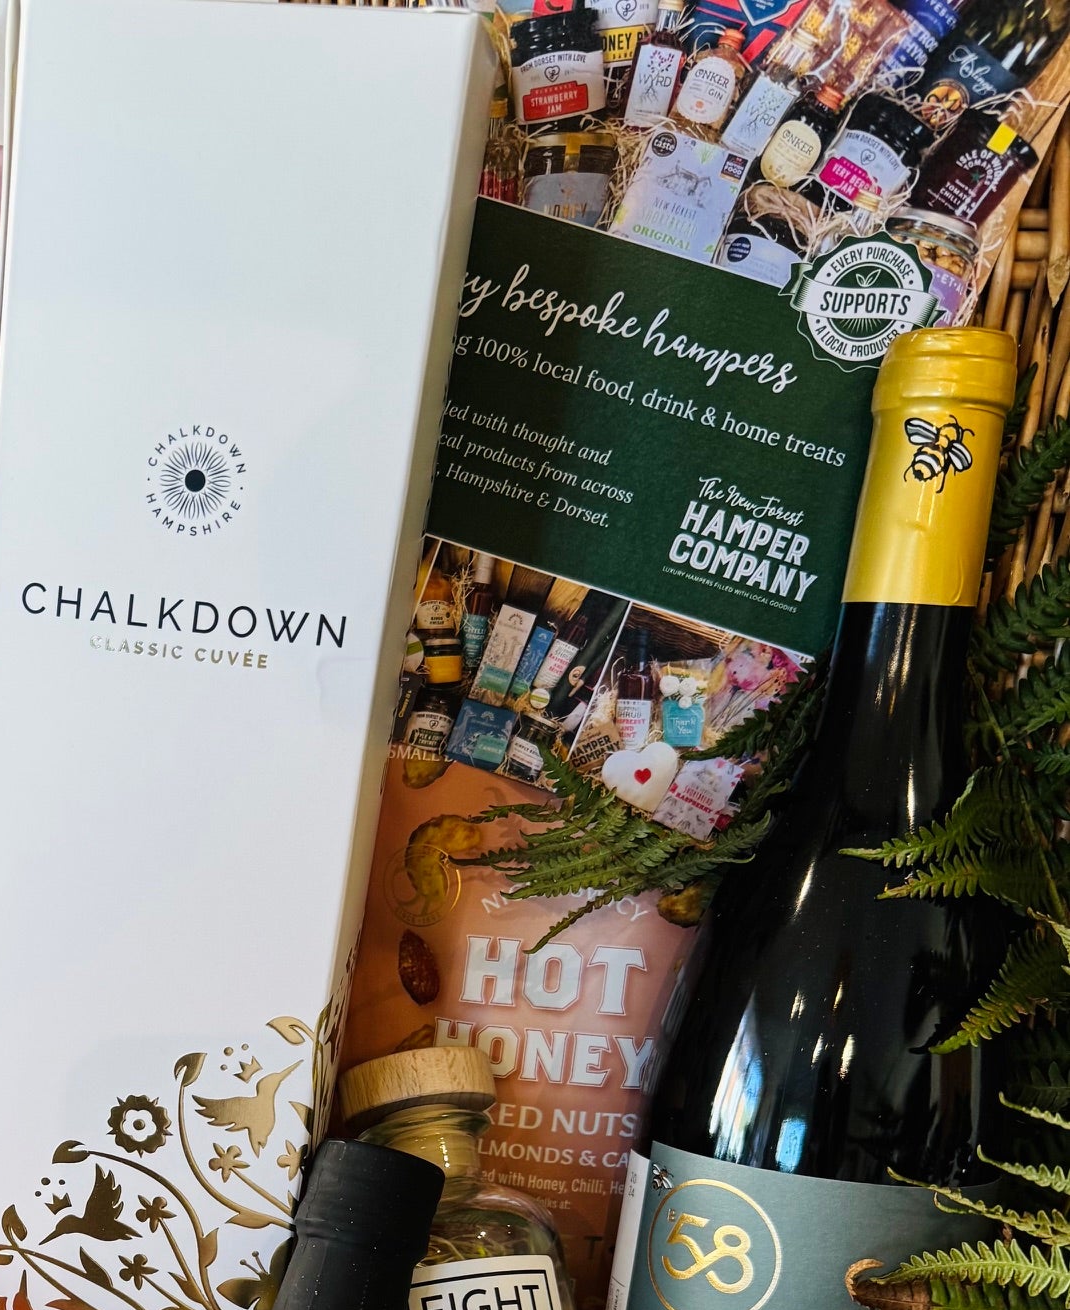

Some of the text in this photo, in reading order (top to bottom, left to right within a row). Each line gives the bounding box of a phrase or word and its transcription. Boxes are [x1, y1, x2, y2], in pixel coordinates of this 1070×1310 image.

[530, 90, 578, 107] STRAWBERRY
[956, 149, 979, 168] ISLE
[633, 224, 691, 251] ORIGINAL
[831, 247, 914, 280] EVERY PURCHASE
[502, 262, 798, 393] bespoke hampers
[820, 291, 911, 316] SUPPORTS
[821, 330, 847, 356] LOCAL
[475, 336, 635, 406] 100% local food,
[147, 425, 247, 475] CHALKDOWN
[472, 413, 613, 466] with thought and
[642, 387, 846, 468] drink home treats
[446, 463, 610, 528] Hampshire Dorset.
[464, 441, 634, 504] products from across
[680, 500, 810, 566] HAMPER
[662, 565, 797, 614] LUXURY HAMPERS FILLED LOCAL GOODIES
[669, 533, 818, 602] COMPANY
[22, 582, 347, 648] CHALKDOWN
[90, 634, 268, 669] CLASSIC CUVÉE
[459, 935, 648, 1017] HOT
[551, 1109, 638, 1137] NUTS
[528, 1175, 606, 1195] Honey, Chilli,
